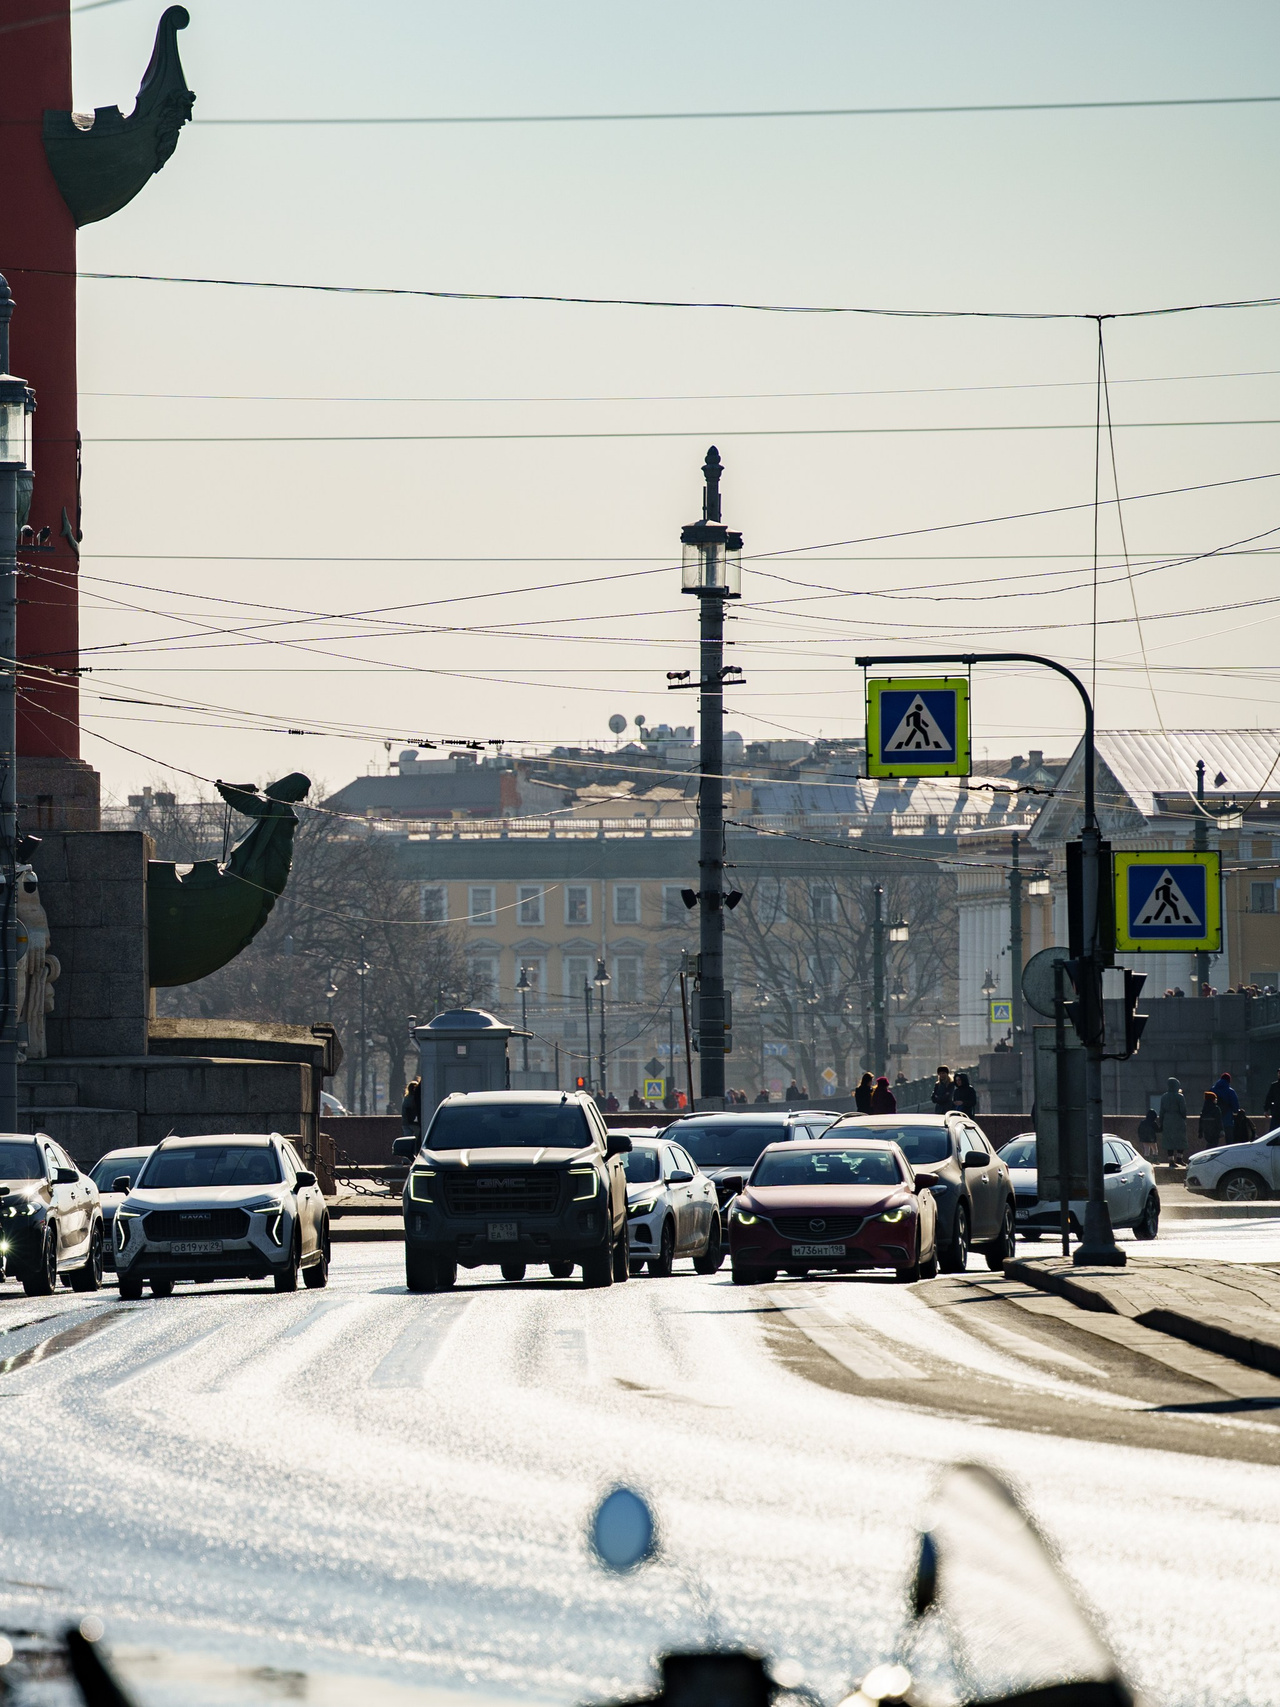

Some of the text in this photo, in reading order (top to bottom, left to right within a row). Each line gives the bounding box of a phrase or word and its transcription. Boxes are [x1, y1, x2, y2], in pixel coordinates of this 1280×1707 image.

[476, 1177, 526, 1189] GMC
[793, 1245, 844, 1255] М736НТ 198
